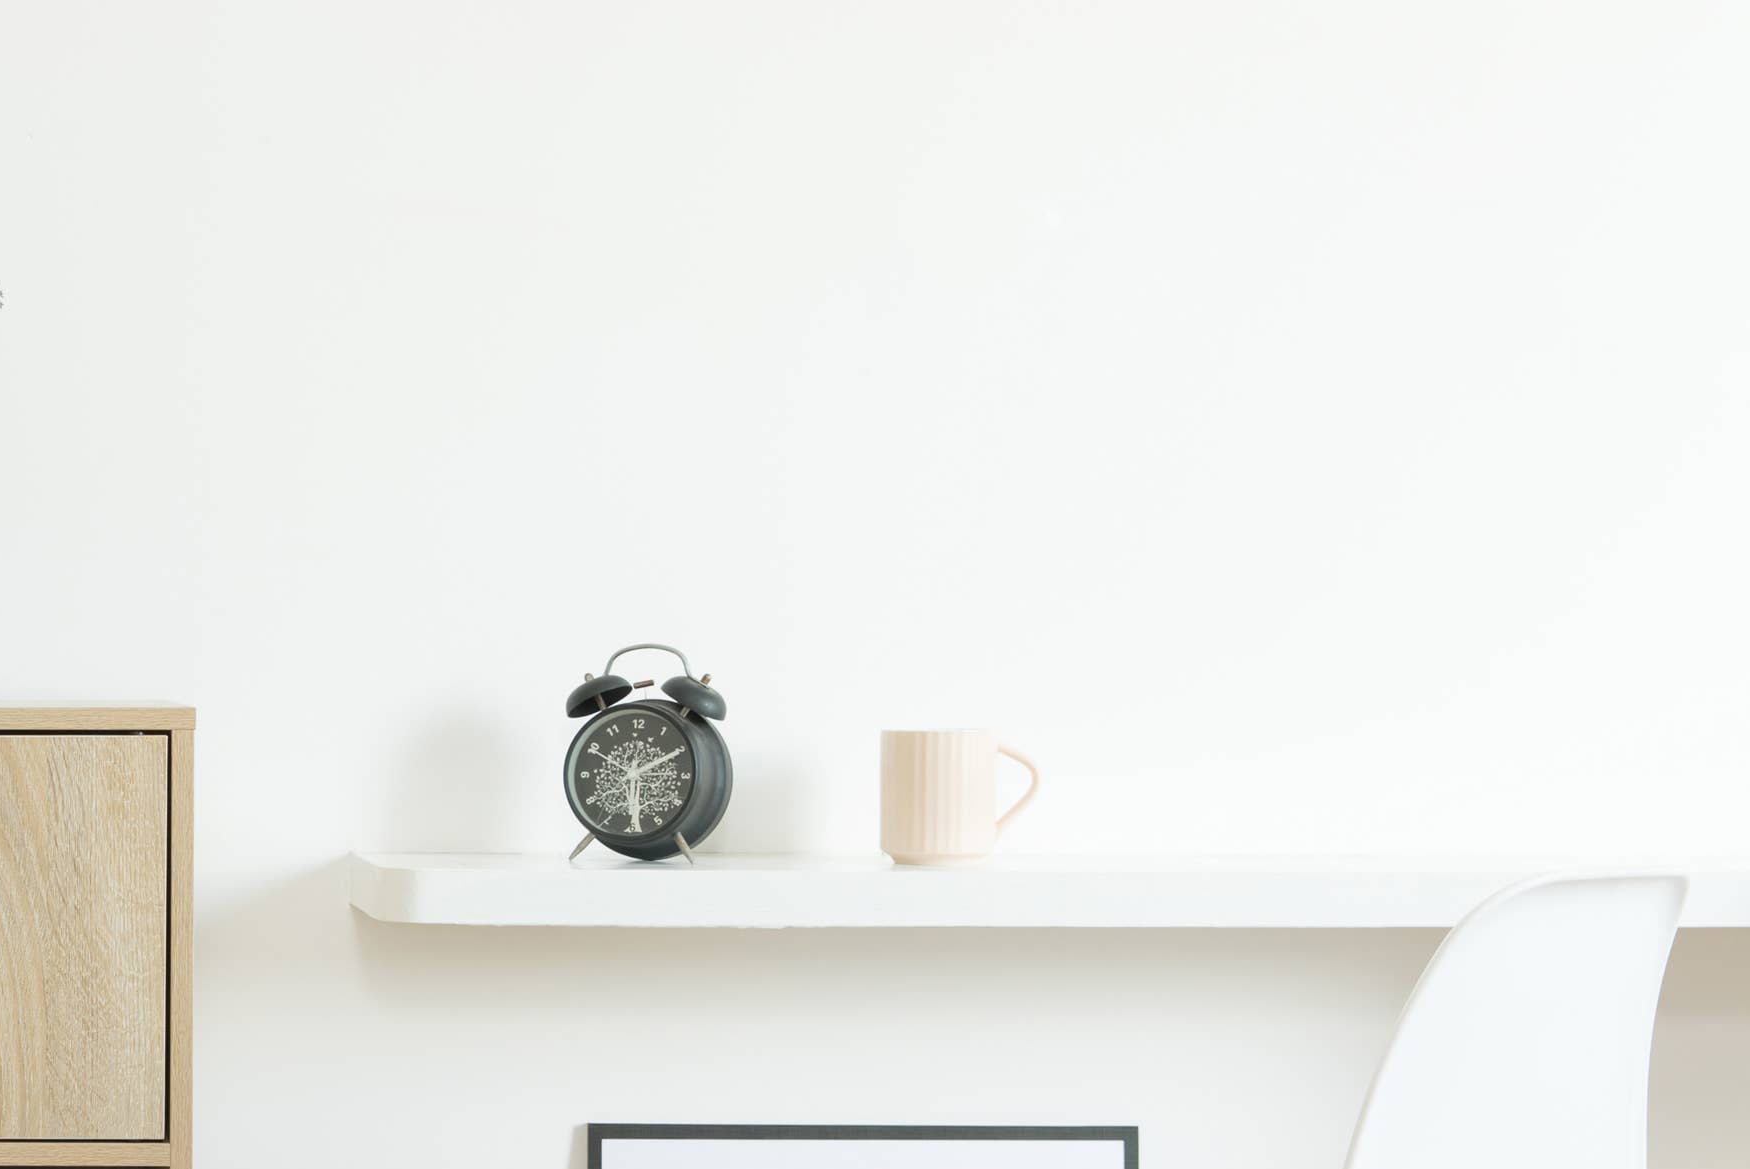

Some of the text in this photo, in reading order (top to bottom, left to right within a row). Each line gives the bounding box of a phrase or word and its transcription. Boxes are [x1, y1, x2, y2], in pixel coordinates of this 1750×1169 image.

[632, 719, 645, 729] 12
[606, 724, 619, 736] 11
[660, 726, 667, 736] 1
[580, 771, 590, 779] 9
[653, 816, 663, 826] 5
